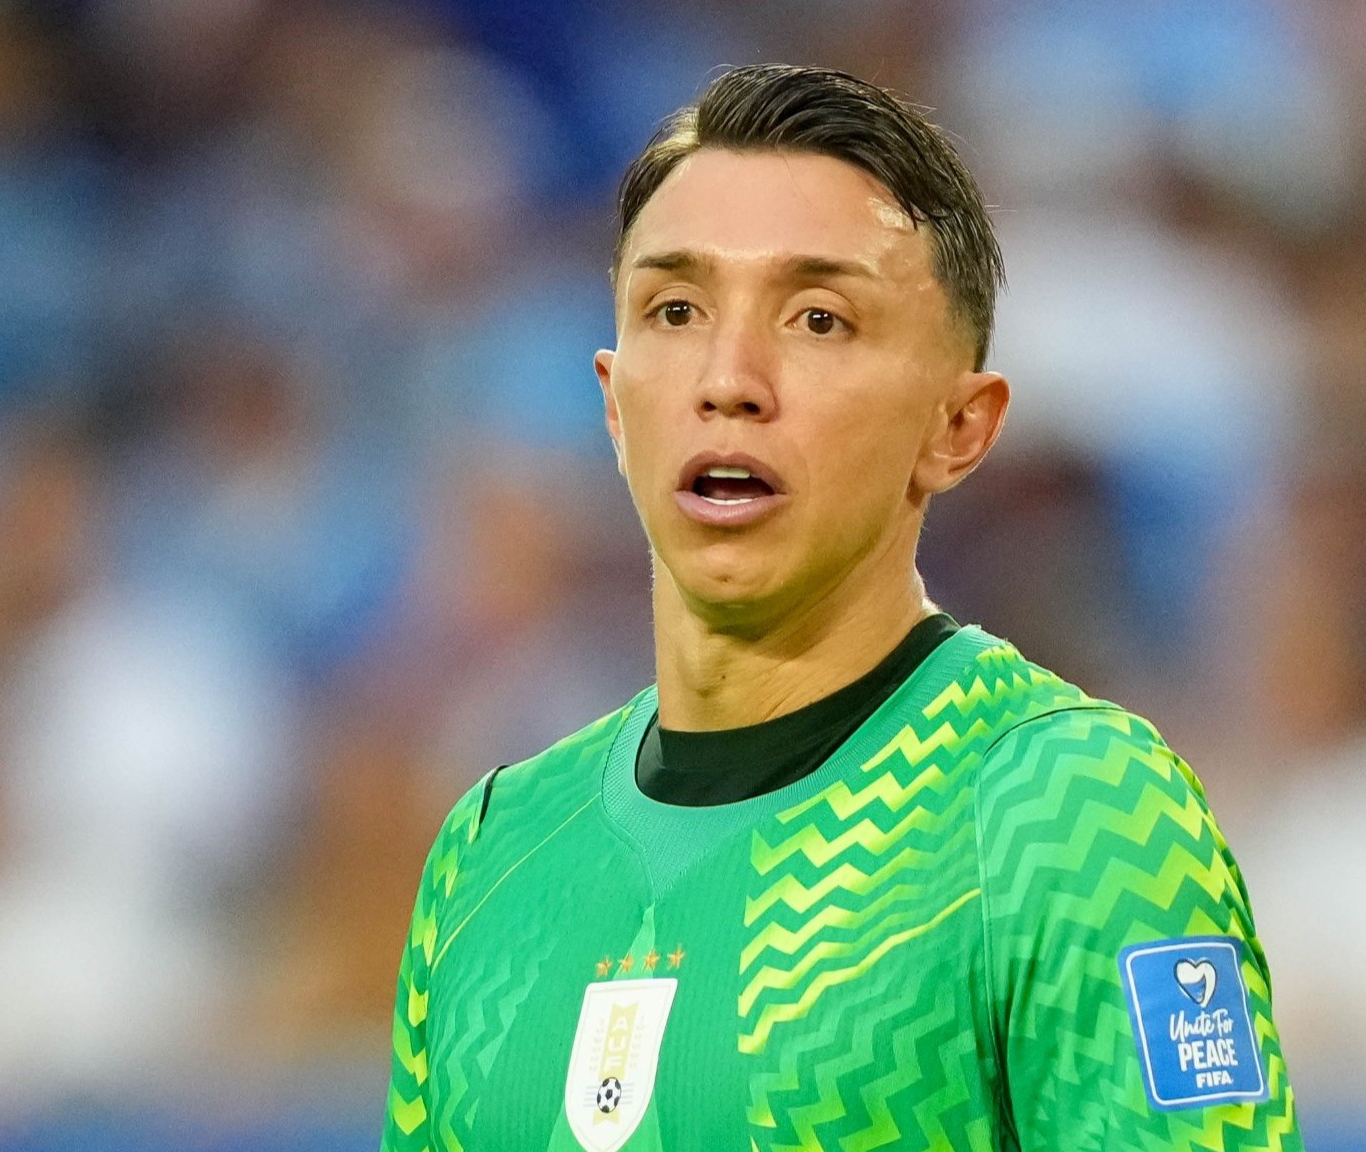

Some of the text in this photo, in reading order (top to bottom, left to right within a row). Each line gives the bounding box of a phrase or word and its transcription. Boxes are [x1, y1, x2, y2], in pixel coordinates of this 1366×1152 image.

[1169, 1008, 1234, 1041] Unite For
[604, 1014, 629, 1073] AUF
[1177, 1038, 1238, 1072] PEACE
[1196, 1070, 1234, 1088] FIFA
